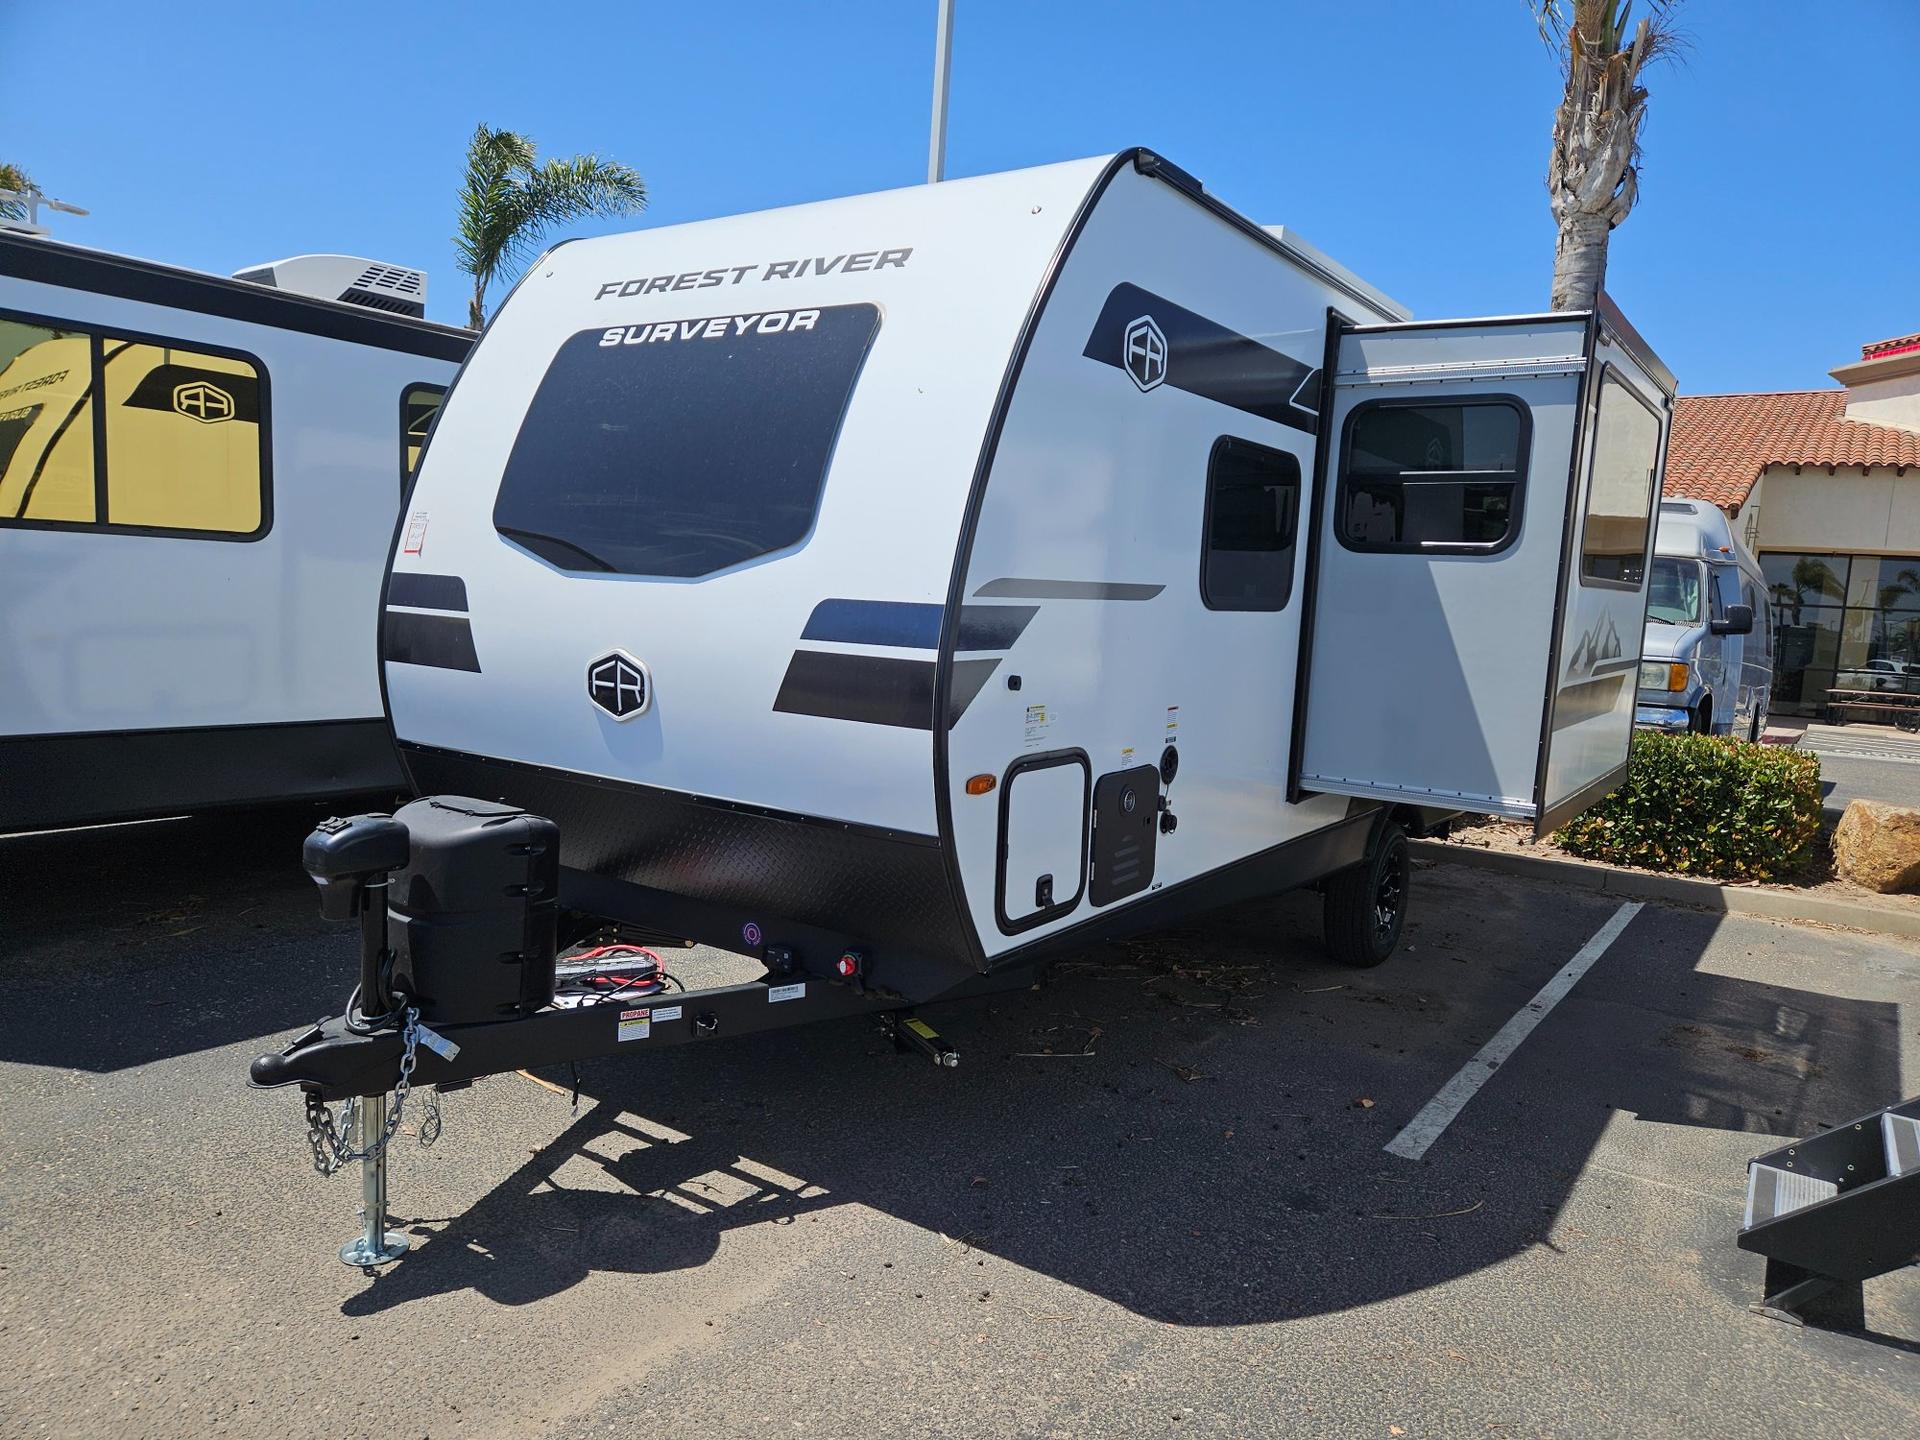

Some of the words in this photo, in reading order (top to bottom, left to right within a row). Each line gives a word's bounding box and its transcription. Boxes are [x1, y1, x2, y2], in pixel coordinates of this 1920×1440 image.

[594, 264, 758, 301] FOREST
[761, 247, 914, 282] RIVER
[599, 309, 821, 347] SURVEYOR
[622, 1009, 649, 1019] PROPANE
